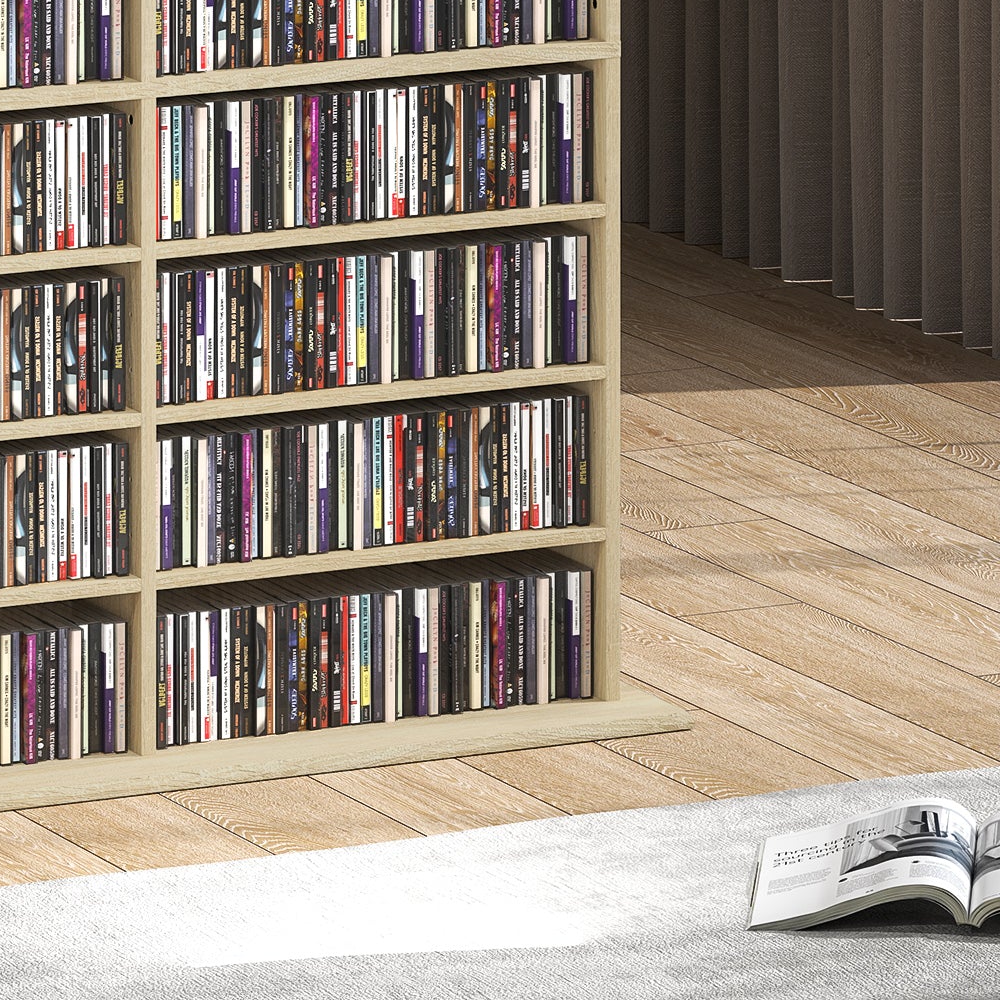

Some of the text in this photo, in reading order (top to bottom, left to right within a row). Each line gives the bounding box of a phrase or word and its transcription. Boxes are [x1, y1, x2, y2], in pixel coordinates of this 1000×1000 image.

[775, 827, 878, 857] Three tips for
[809, 840, 866, 860] century
[774, 845, 838, 862] sourcing
